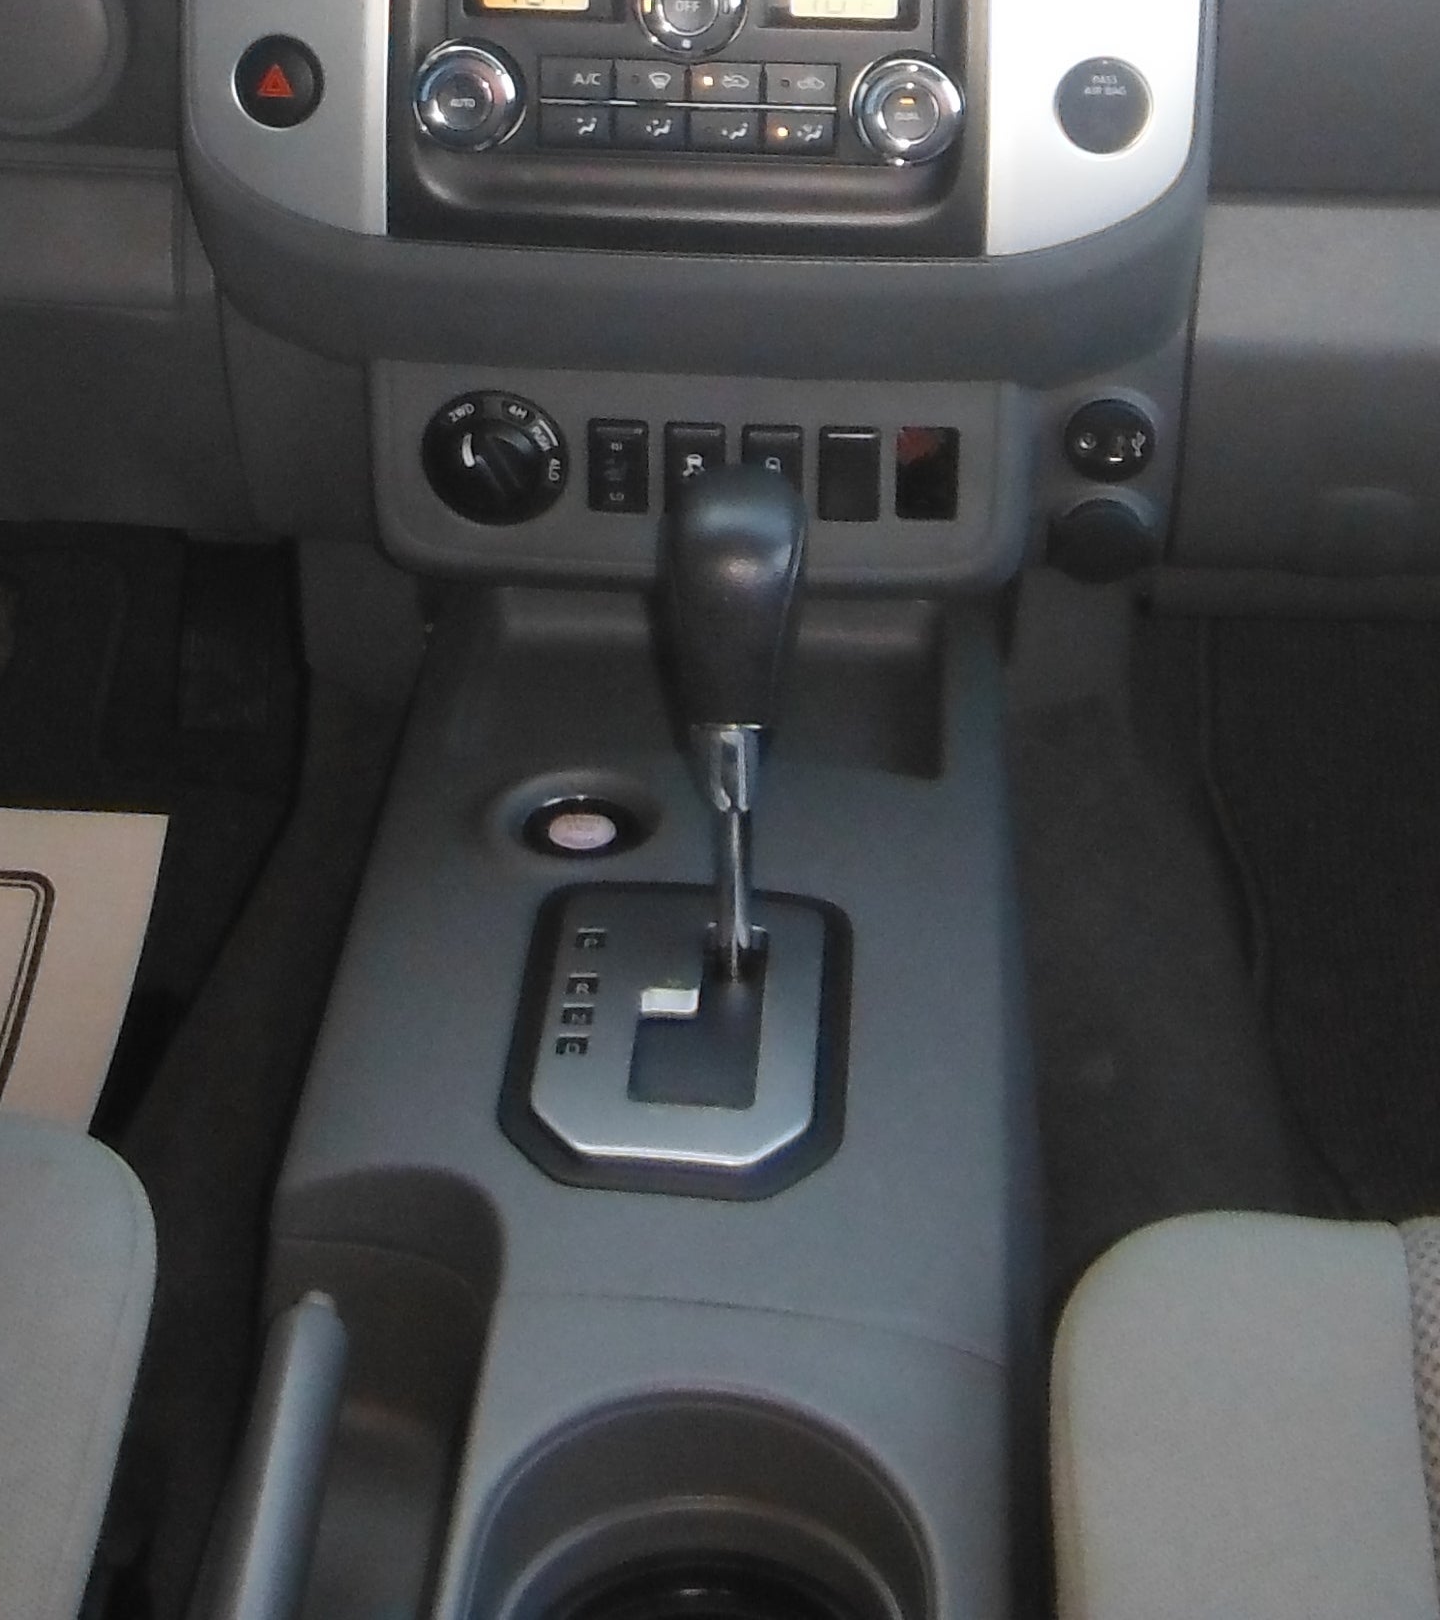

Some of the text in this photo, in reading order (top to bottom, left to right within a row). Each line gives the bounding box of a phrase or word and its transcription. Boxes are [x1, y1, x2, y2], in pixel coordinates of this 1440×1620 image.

[675, 0, 700, 12] OFF
[573, 72, 602, 86] A/C
[447, 402, 476, 423] 2WD
